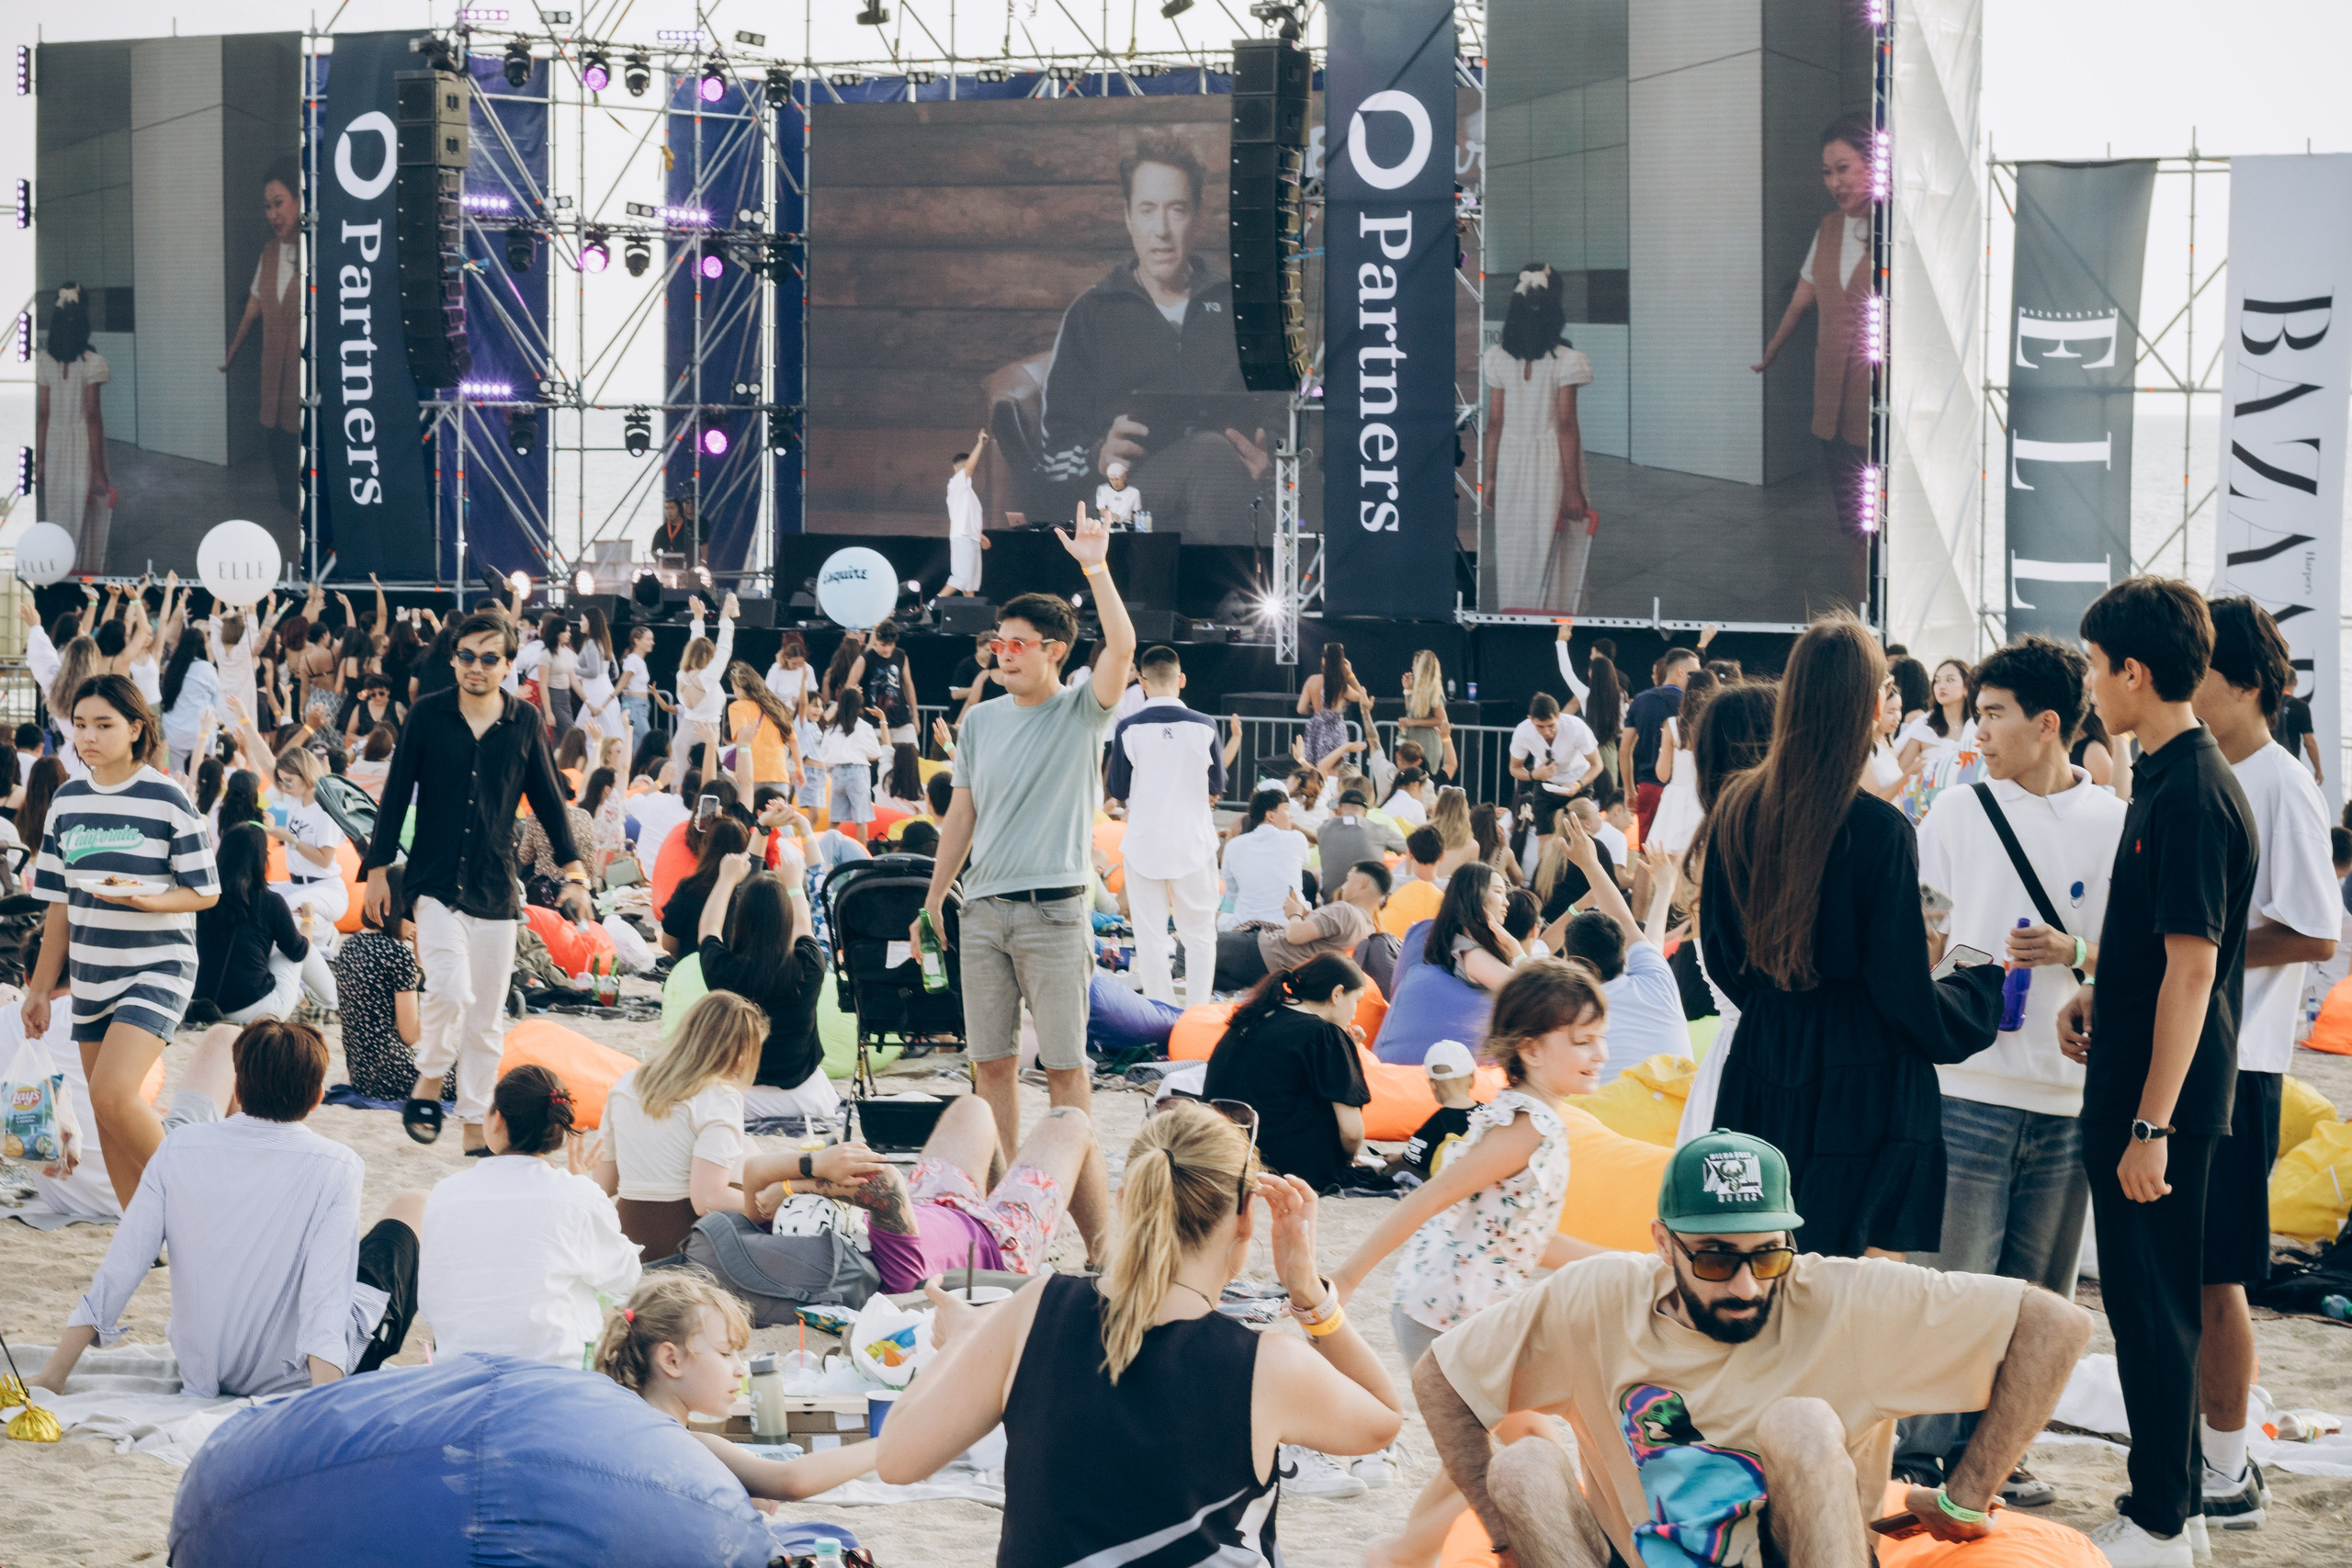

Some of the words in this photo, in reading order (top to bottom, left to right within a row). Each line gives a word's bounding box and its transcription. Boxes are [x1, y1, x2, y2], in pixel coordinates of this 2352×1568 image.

[339, 218, 383, 505] Partners
[1358, 209, 1414, 533] Partners
[2011, 306, 2119, 610] ELL
[218, 560, 266, 581] ELLE
